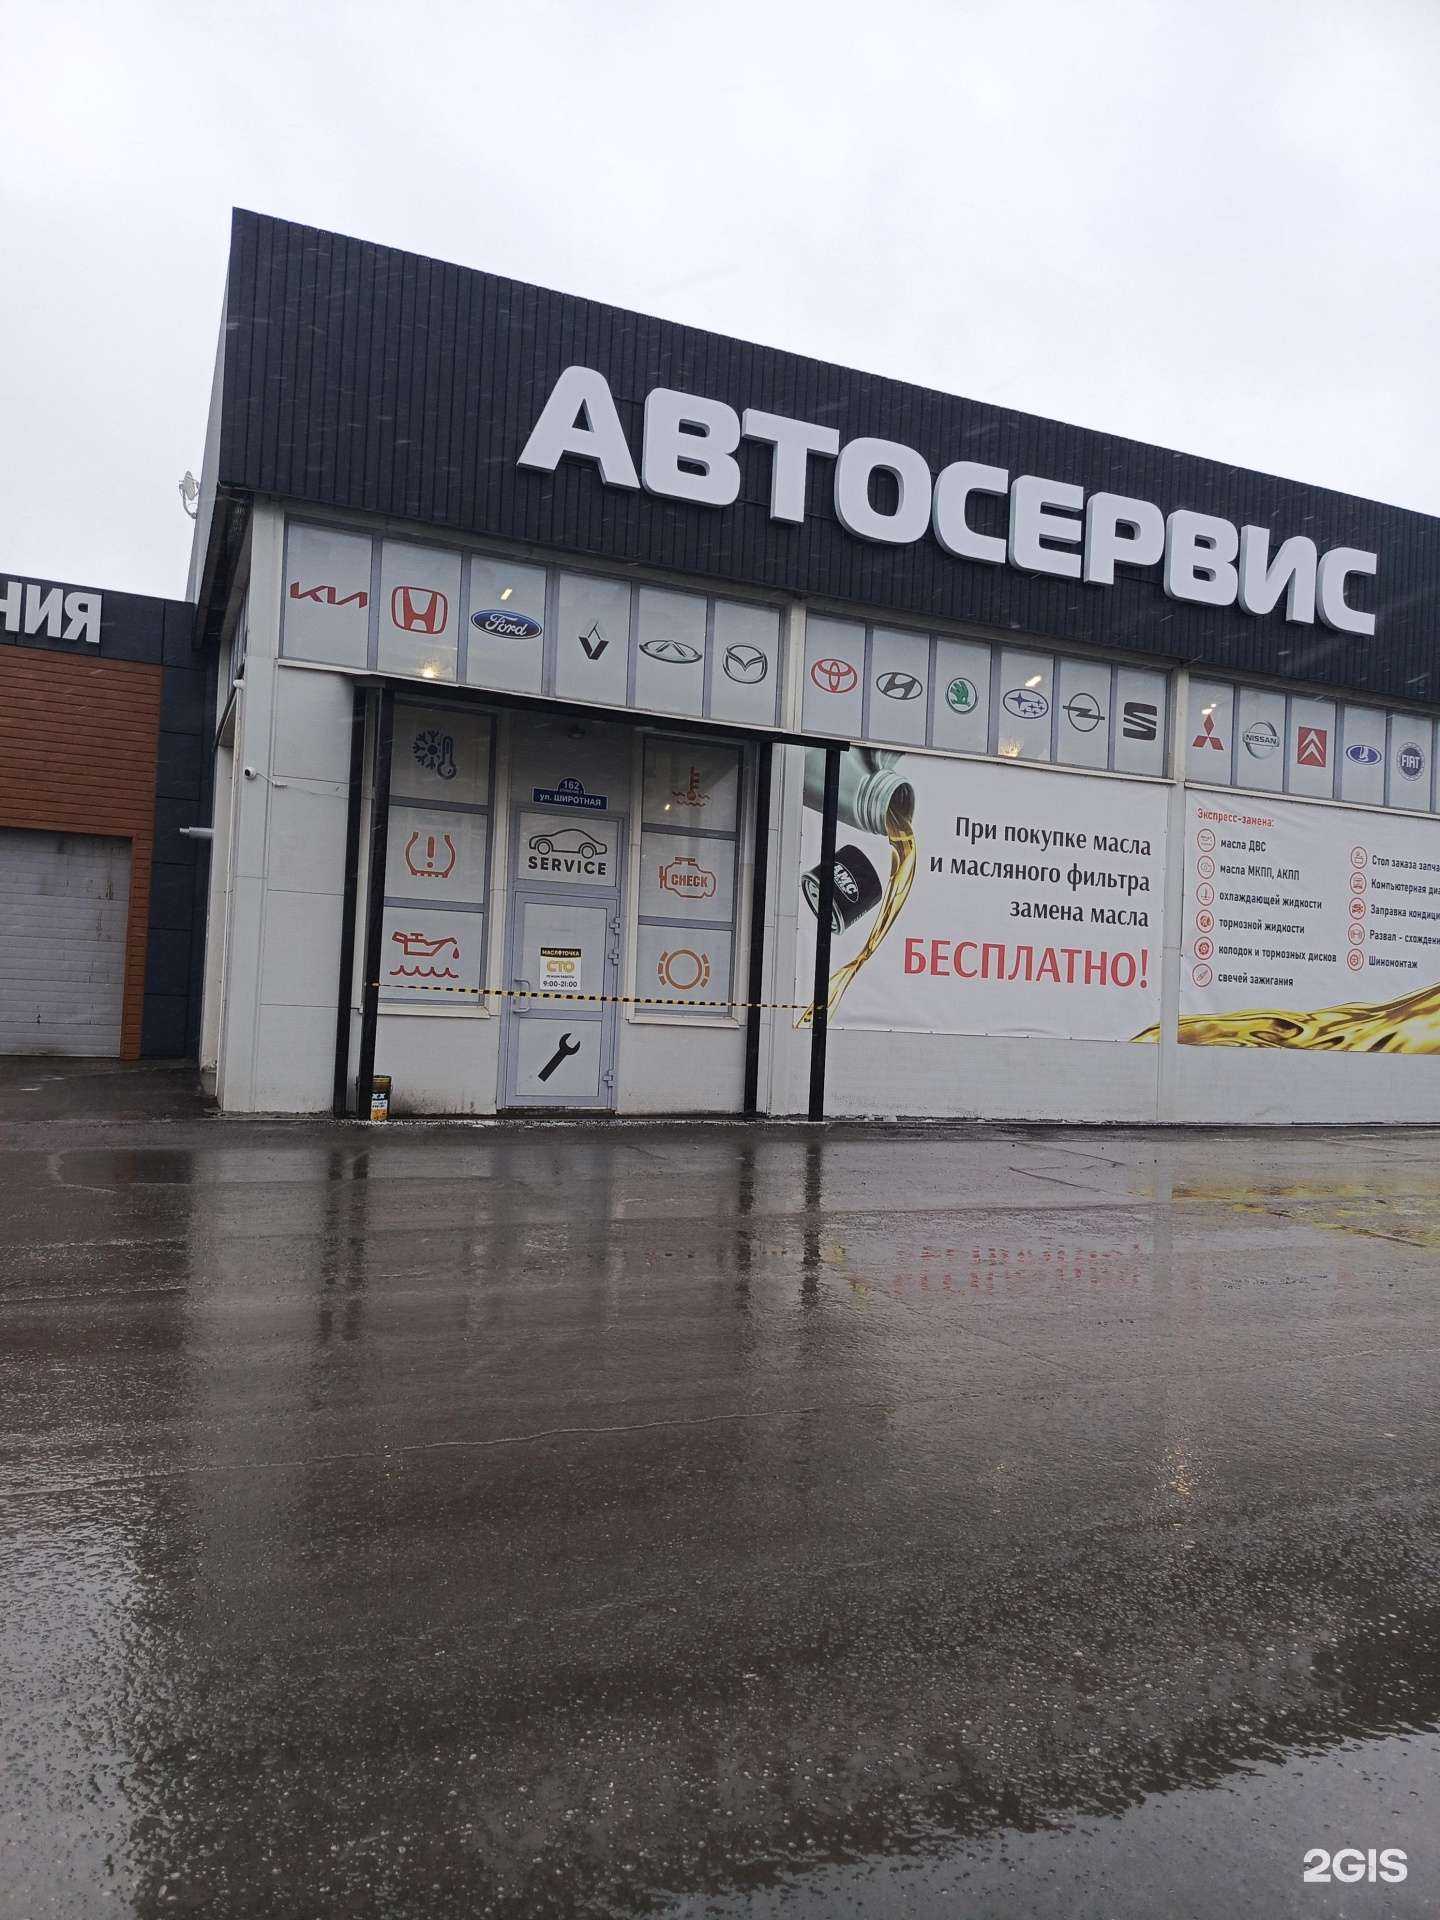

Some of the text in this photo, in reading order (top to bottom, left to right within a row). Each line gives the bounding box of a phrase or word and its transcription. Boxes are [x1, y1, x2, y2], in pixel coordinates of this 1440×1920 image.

[517, 366, 1378, 636] АВТОСЕРВИС
[484, 613, 527, 637] Ford
[1246, 734, 1277, 745] NISSAN
[1401, 754, 1420, 769] FIAT
[563, 780, 580, 790] 162
[554, 795, 601, 807] ШИРОТНАЯ
[1197, 808, 1275, 828] Экспресс-замена:
[955, 816, 1152, 856] При покупке масла
[1221, 840, 1246, 850] масла
[1248, 841, 1267, 852] ДВС
[528, 856, 607, 876] SERVICE
[1371, 854, 1390, 867] Стол
[1392, 859, 1417, 870] заказа
[930, 856, 1151, 895] и масляного фильтра
[1220, 865, 1300, 880] масла МКПП, АКПП
[671, 874, 708, 888] CHECK
[1371, 878, 1427, 894] Компьютерная
[1219, 892, 1322, 910] охлаждающей жидкости
[1010, 900, 1149, 928] замена масла
[1370, 904, 1407, 917] Заправка
[1219, 918, 1305, 935] тормозной жидкости
[1369, 929, 1397, 941] Развал
[1218, 945, 1337, 963] колодок и тормозных дисков
[1368, 955, 1418, 968] Шиномонтаж
[904, 937, 1149, 989] БЕСПЛАТНО!
[1218, 972, 1294, 987] свечей зажигания
